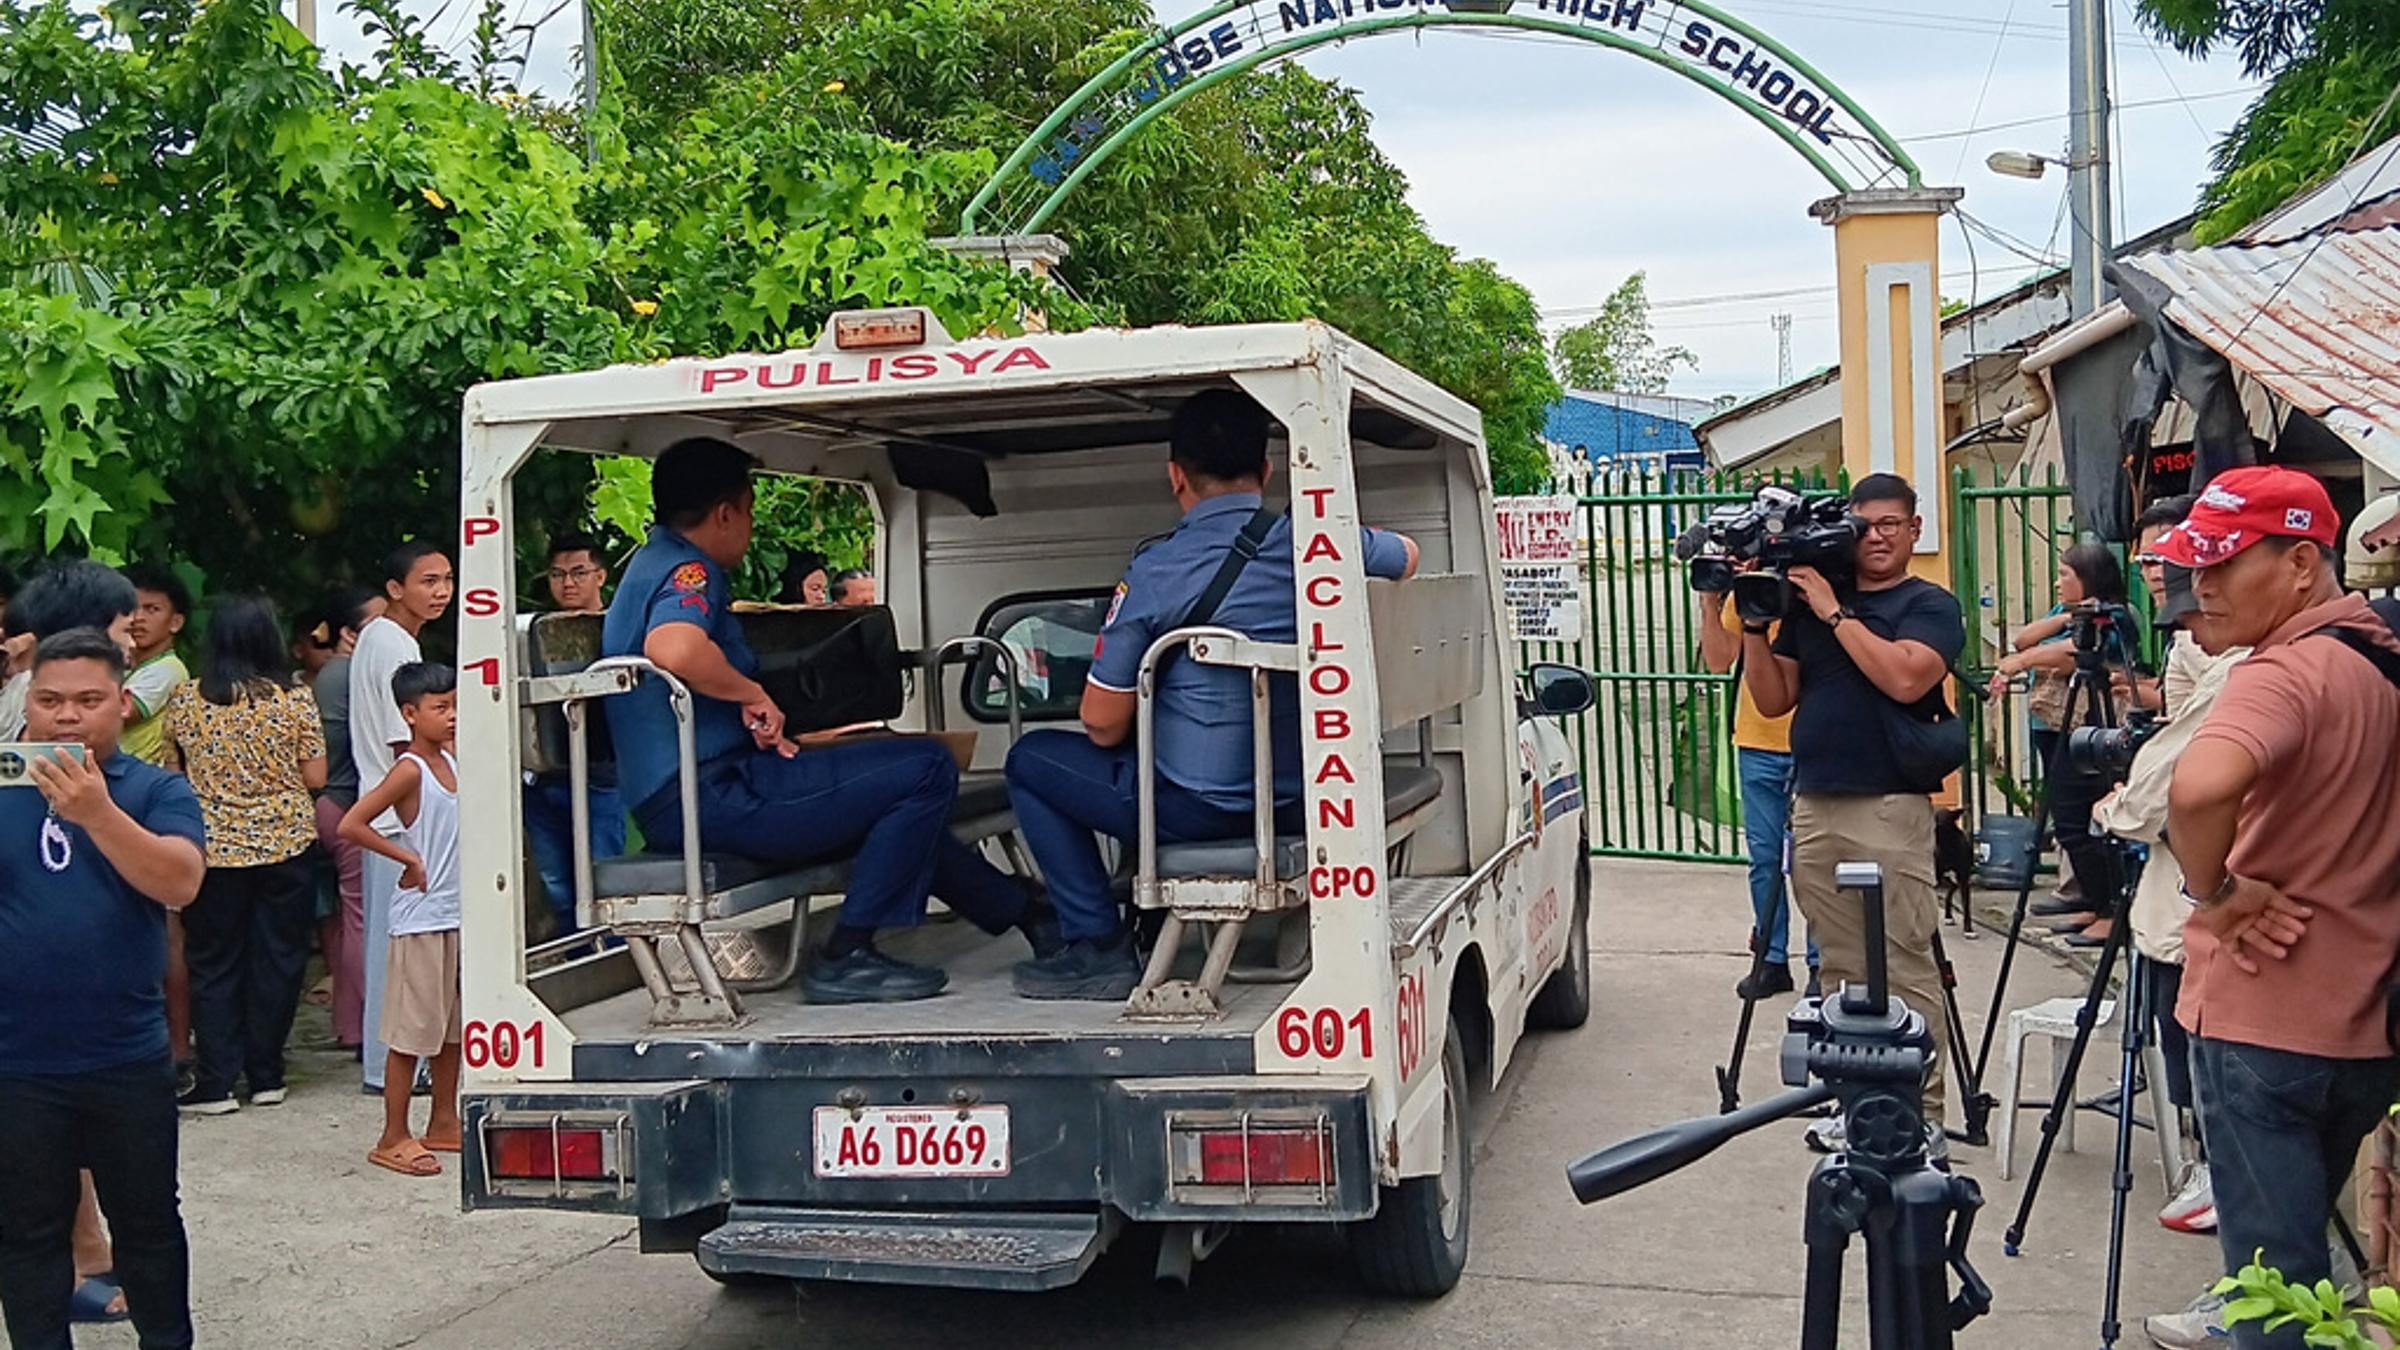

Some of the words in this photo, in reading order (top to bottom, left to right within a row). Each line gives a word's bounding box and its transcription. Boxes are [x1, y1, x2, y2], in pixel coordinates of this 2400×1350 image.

[1134, 20, 1243, 104] JOSE
[1679, 21, 1834, 146] SCHOOL
[701, 346, 1051, 393] PULISYA
[1302, 488, 1356, 829] TACLOBAN
[1309, 865, 1376, 899] CPO
[464, 1020, 544, 1069] 601
[1277, 1007, 1373, 1059] 601
[1397, 965, 1427, 1083] 601
[837, 1126, 881, 1166] A6
[895, 1124, 986, 1166] D669
